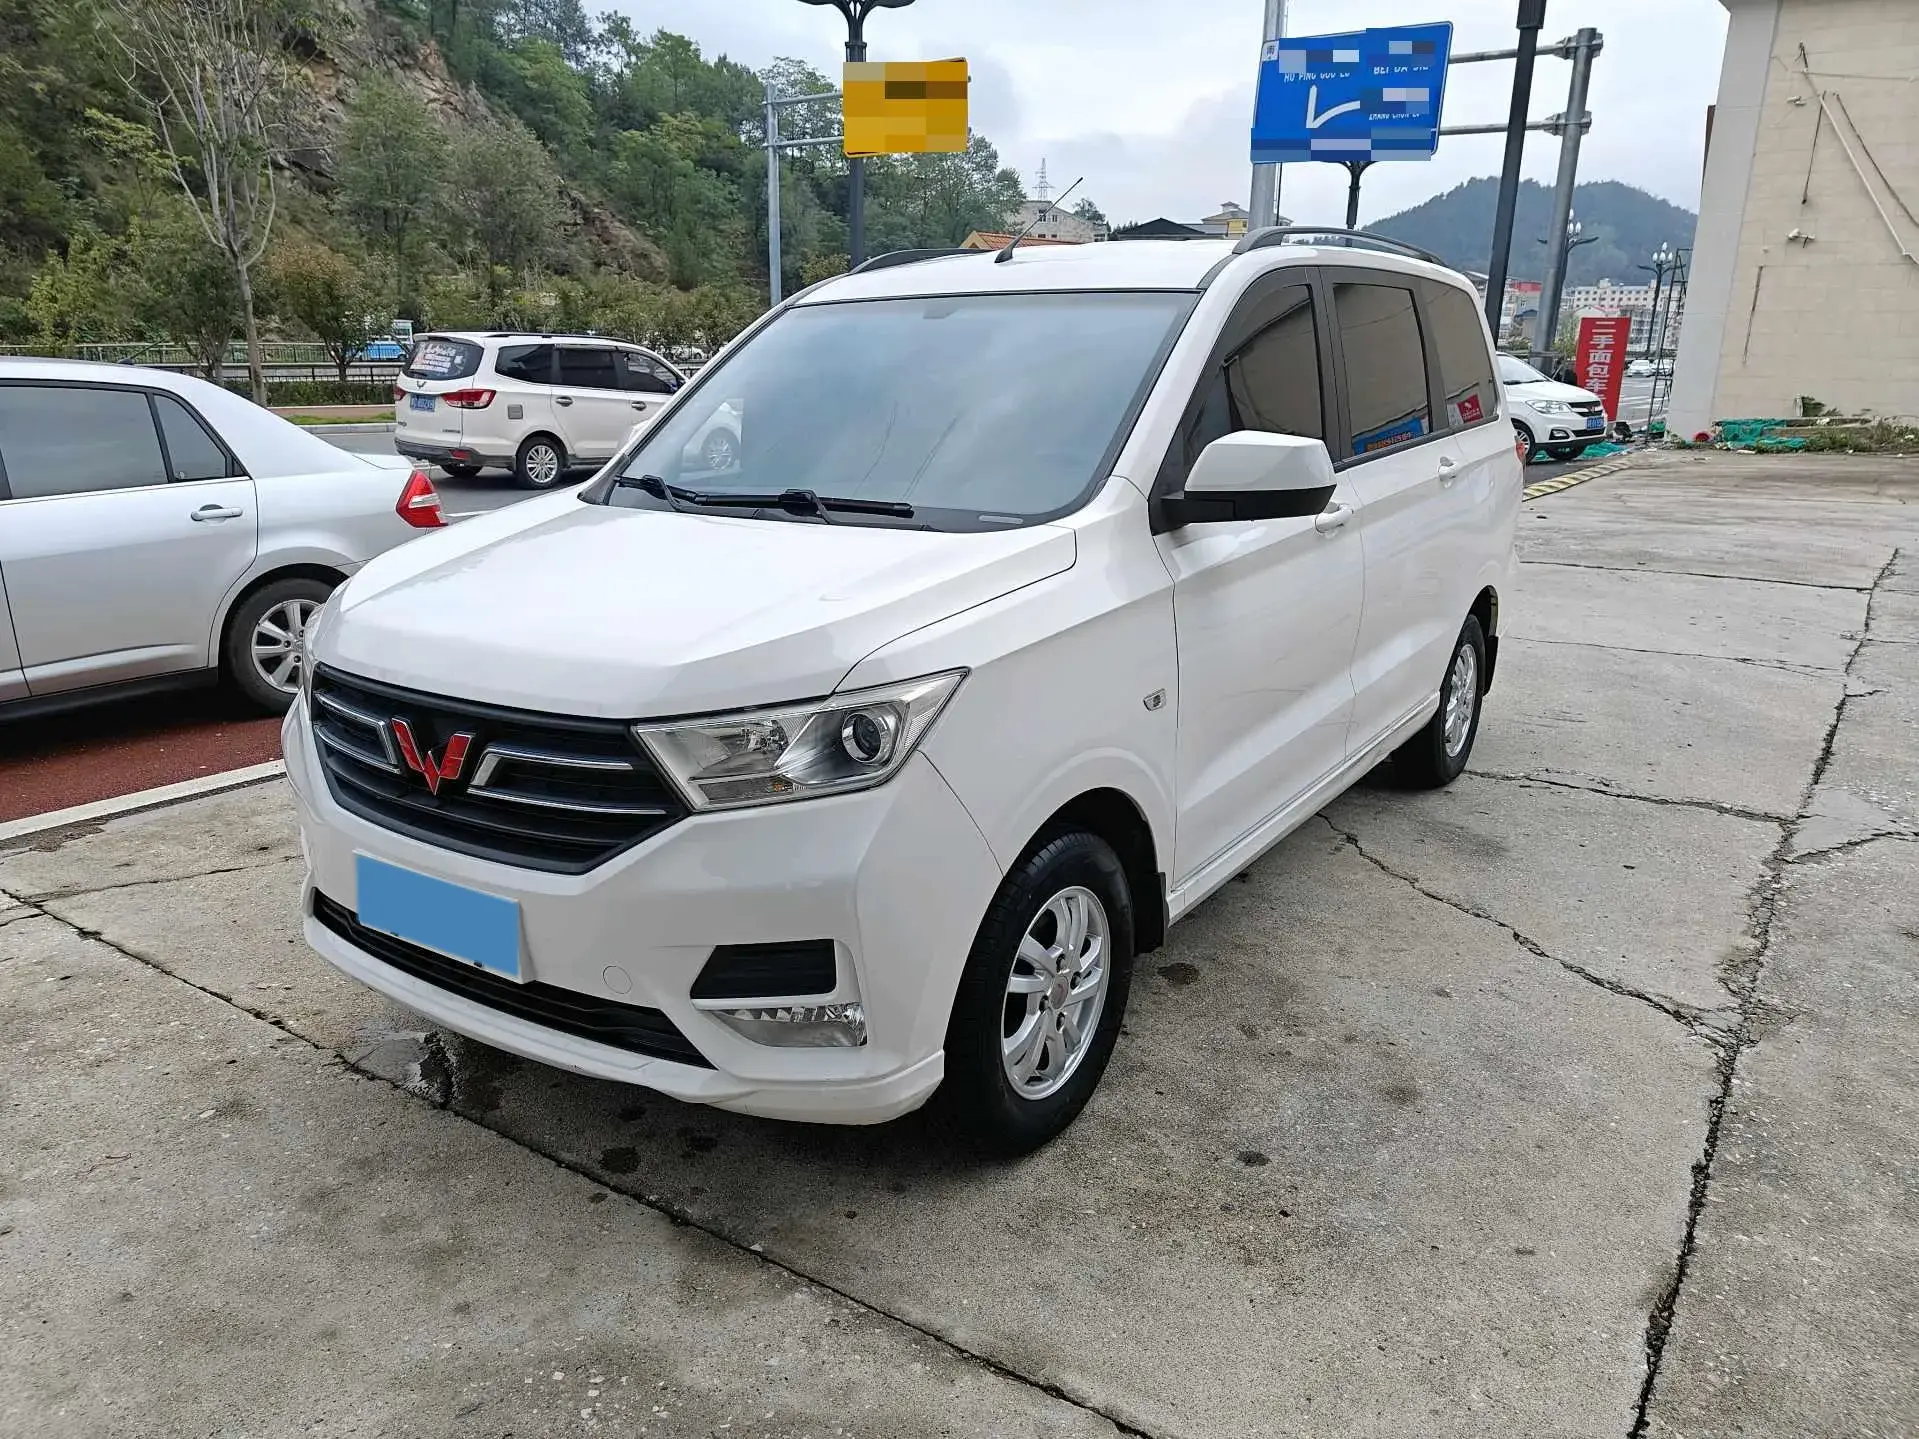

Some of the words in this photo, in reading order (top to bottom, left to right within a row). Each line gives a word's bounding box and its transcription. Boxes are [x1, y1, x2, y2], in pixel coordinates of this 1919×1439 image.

[1584, 321, 1616, 400] 二手面包车
